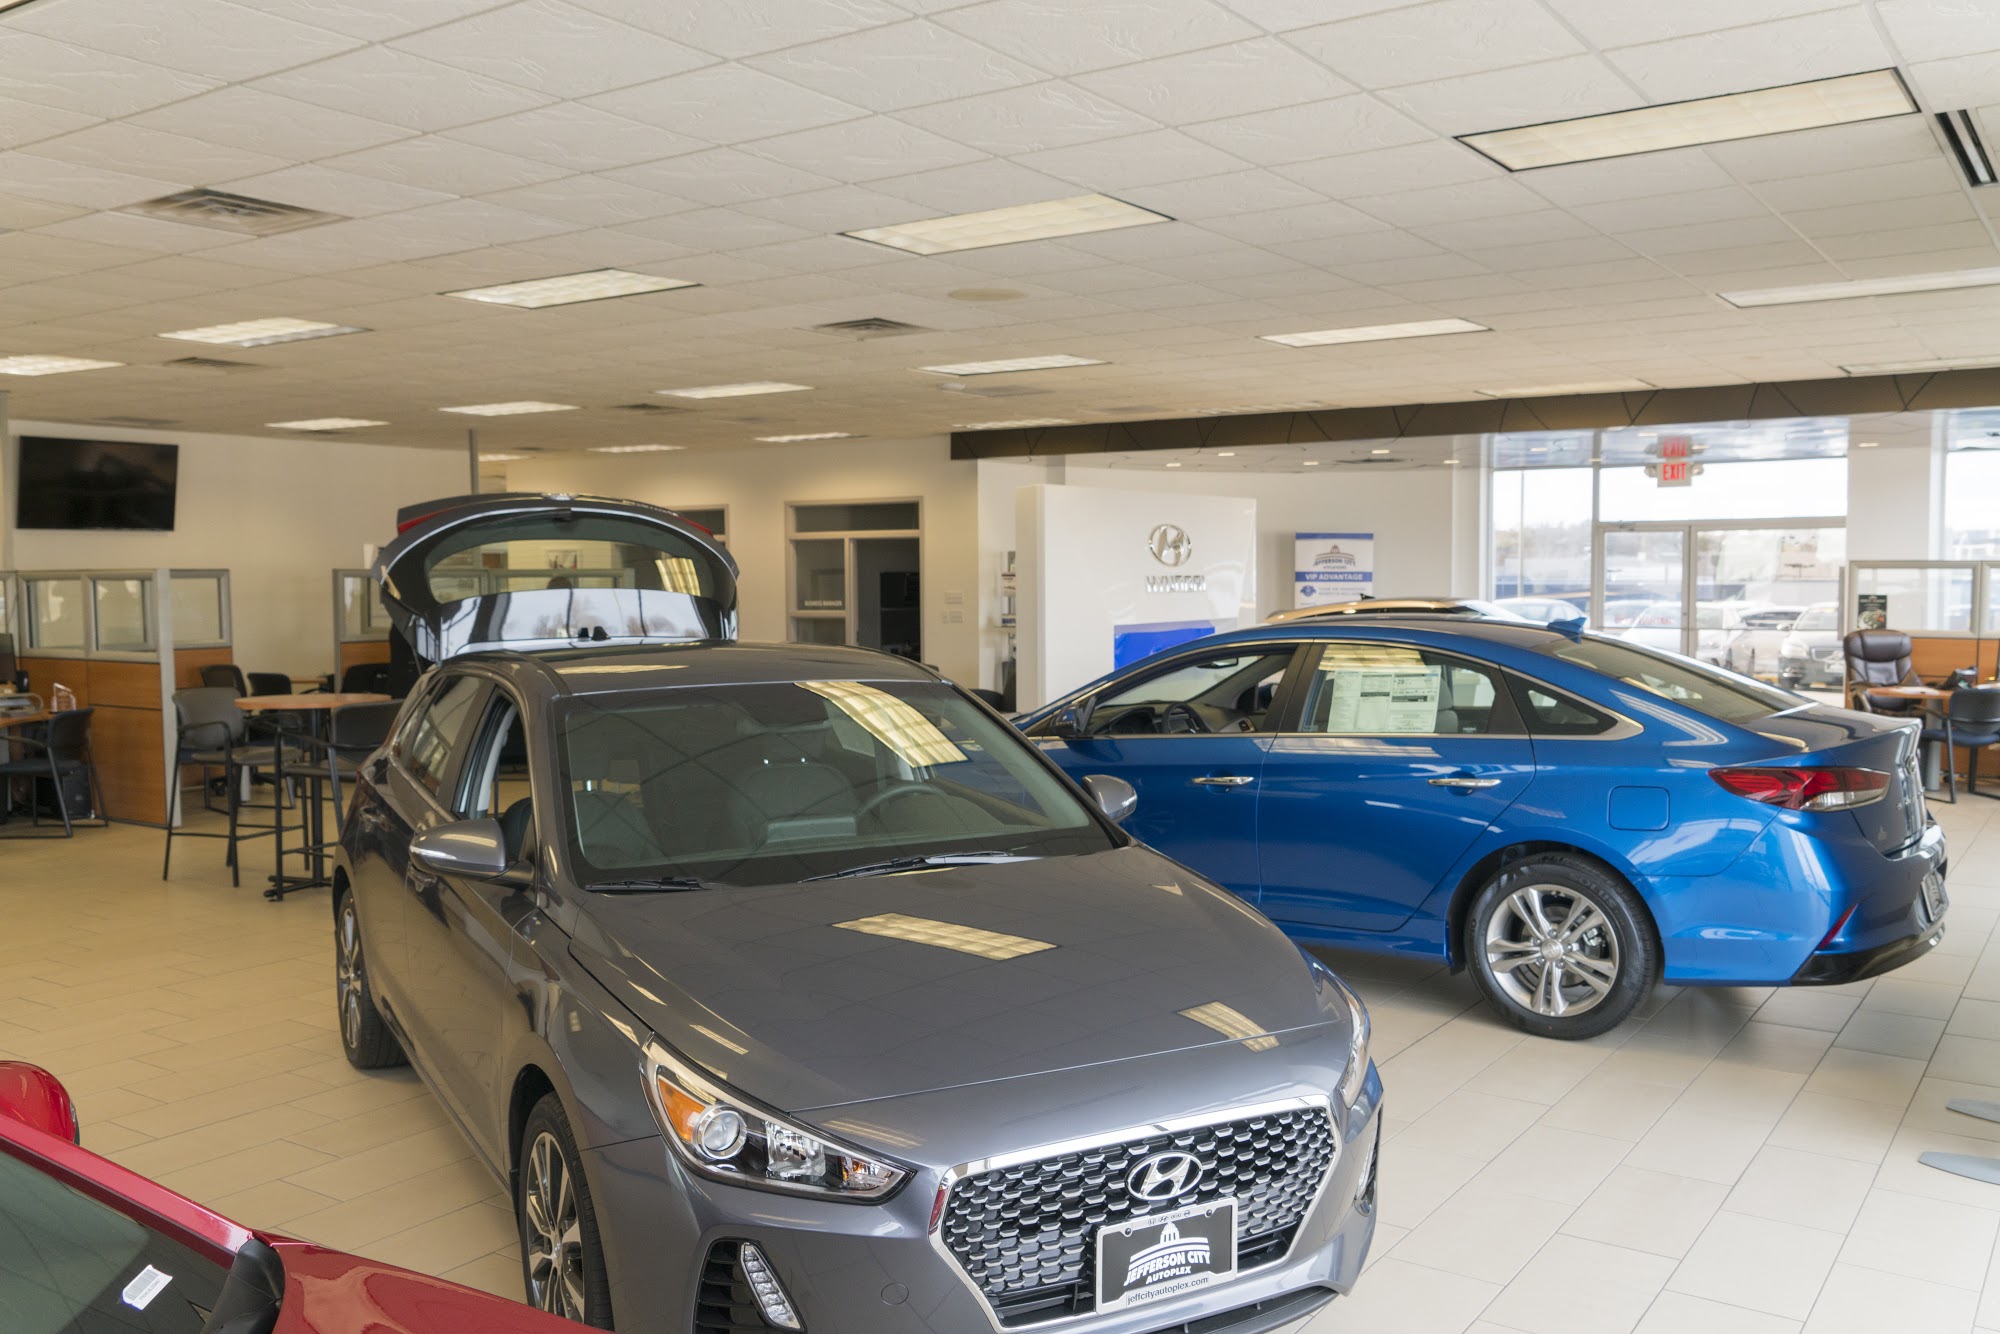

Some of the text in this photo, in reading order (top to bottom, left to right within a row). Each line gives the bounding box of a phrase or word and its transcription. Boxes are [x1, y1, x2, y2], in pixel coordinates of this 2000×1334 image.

[1663, 463, 1686, 480] EXIT
[1123, 1251, 1210, 1286] JEFFERSON CITY
[1146, 1266, 1191, 1284] AUTOPLEX
[1127, 1277, 1208, 1305] jeffcityautoplex.com
